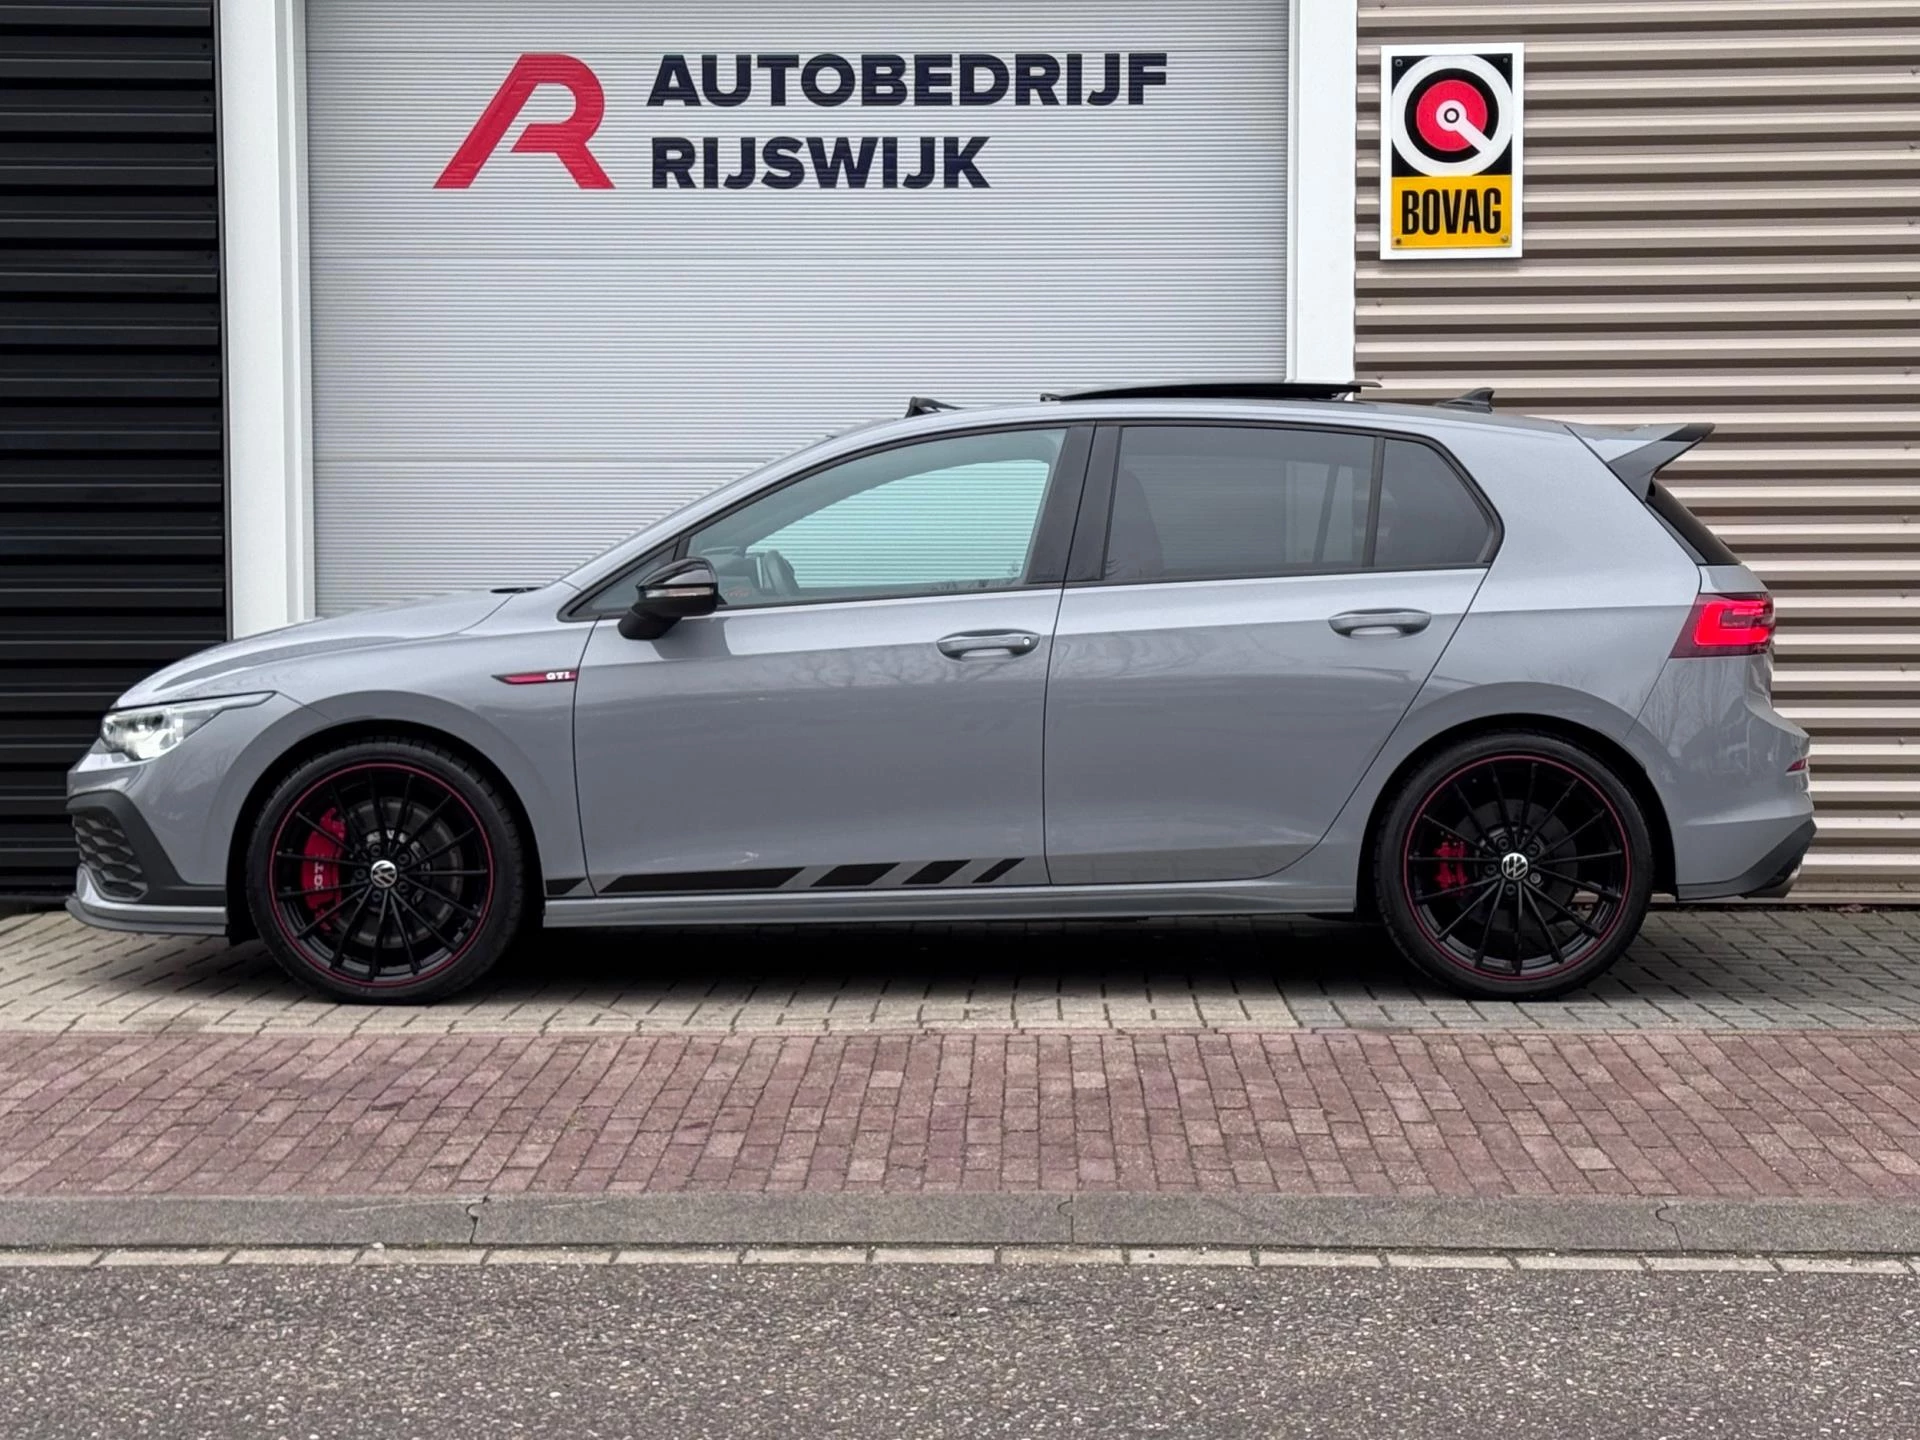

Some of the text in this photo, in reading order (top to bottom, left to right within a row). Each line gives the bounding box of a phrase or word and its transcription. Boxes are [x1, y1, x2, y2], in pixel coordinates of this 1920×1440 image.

[646, 52, 1168, 107] AUTOBEDRIJF
[652, 136, 991, 190] RIJSWIJK
[1401, 187, 1502, 236] BOVAG
[545, 671, 571, 681] GTI
